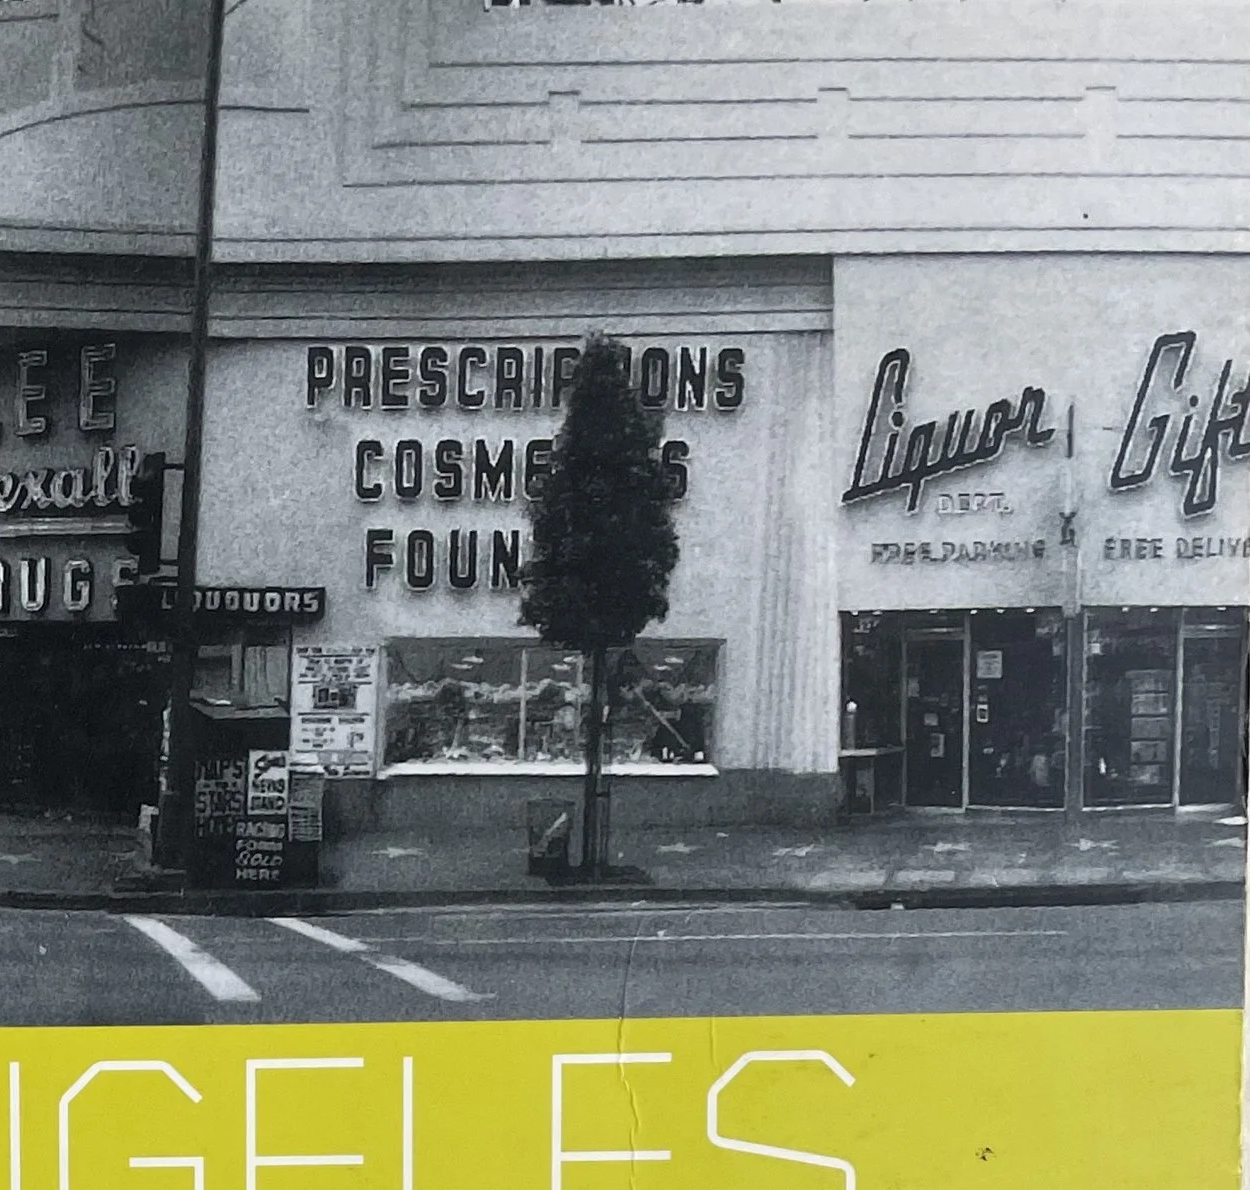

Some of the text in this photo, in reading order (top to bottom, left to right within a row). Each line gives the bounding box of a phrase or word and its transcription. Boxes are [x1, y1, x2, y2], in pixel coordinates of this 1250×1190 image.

[841, 348, 1056, 514] Liquor
[355, 440, 690, 501] COSMES
[1104, 537, 1163, 562] FREE
